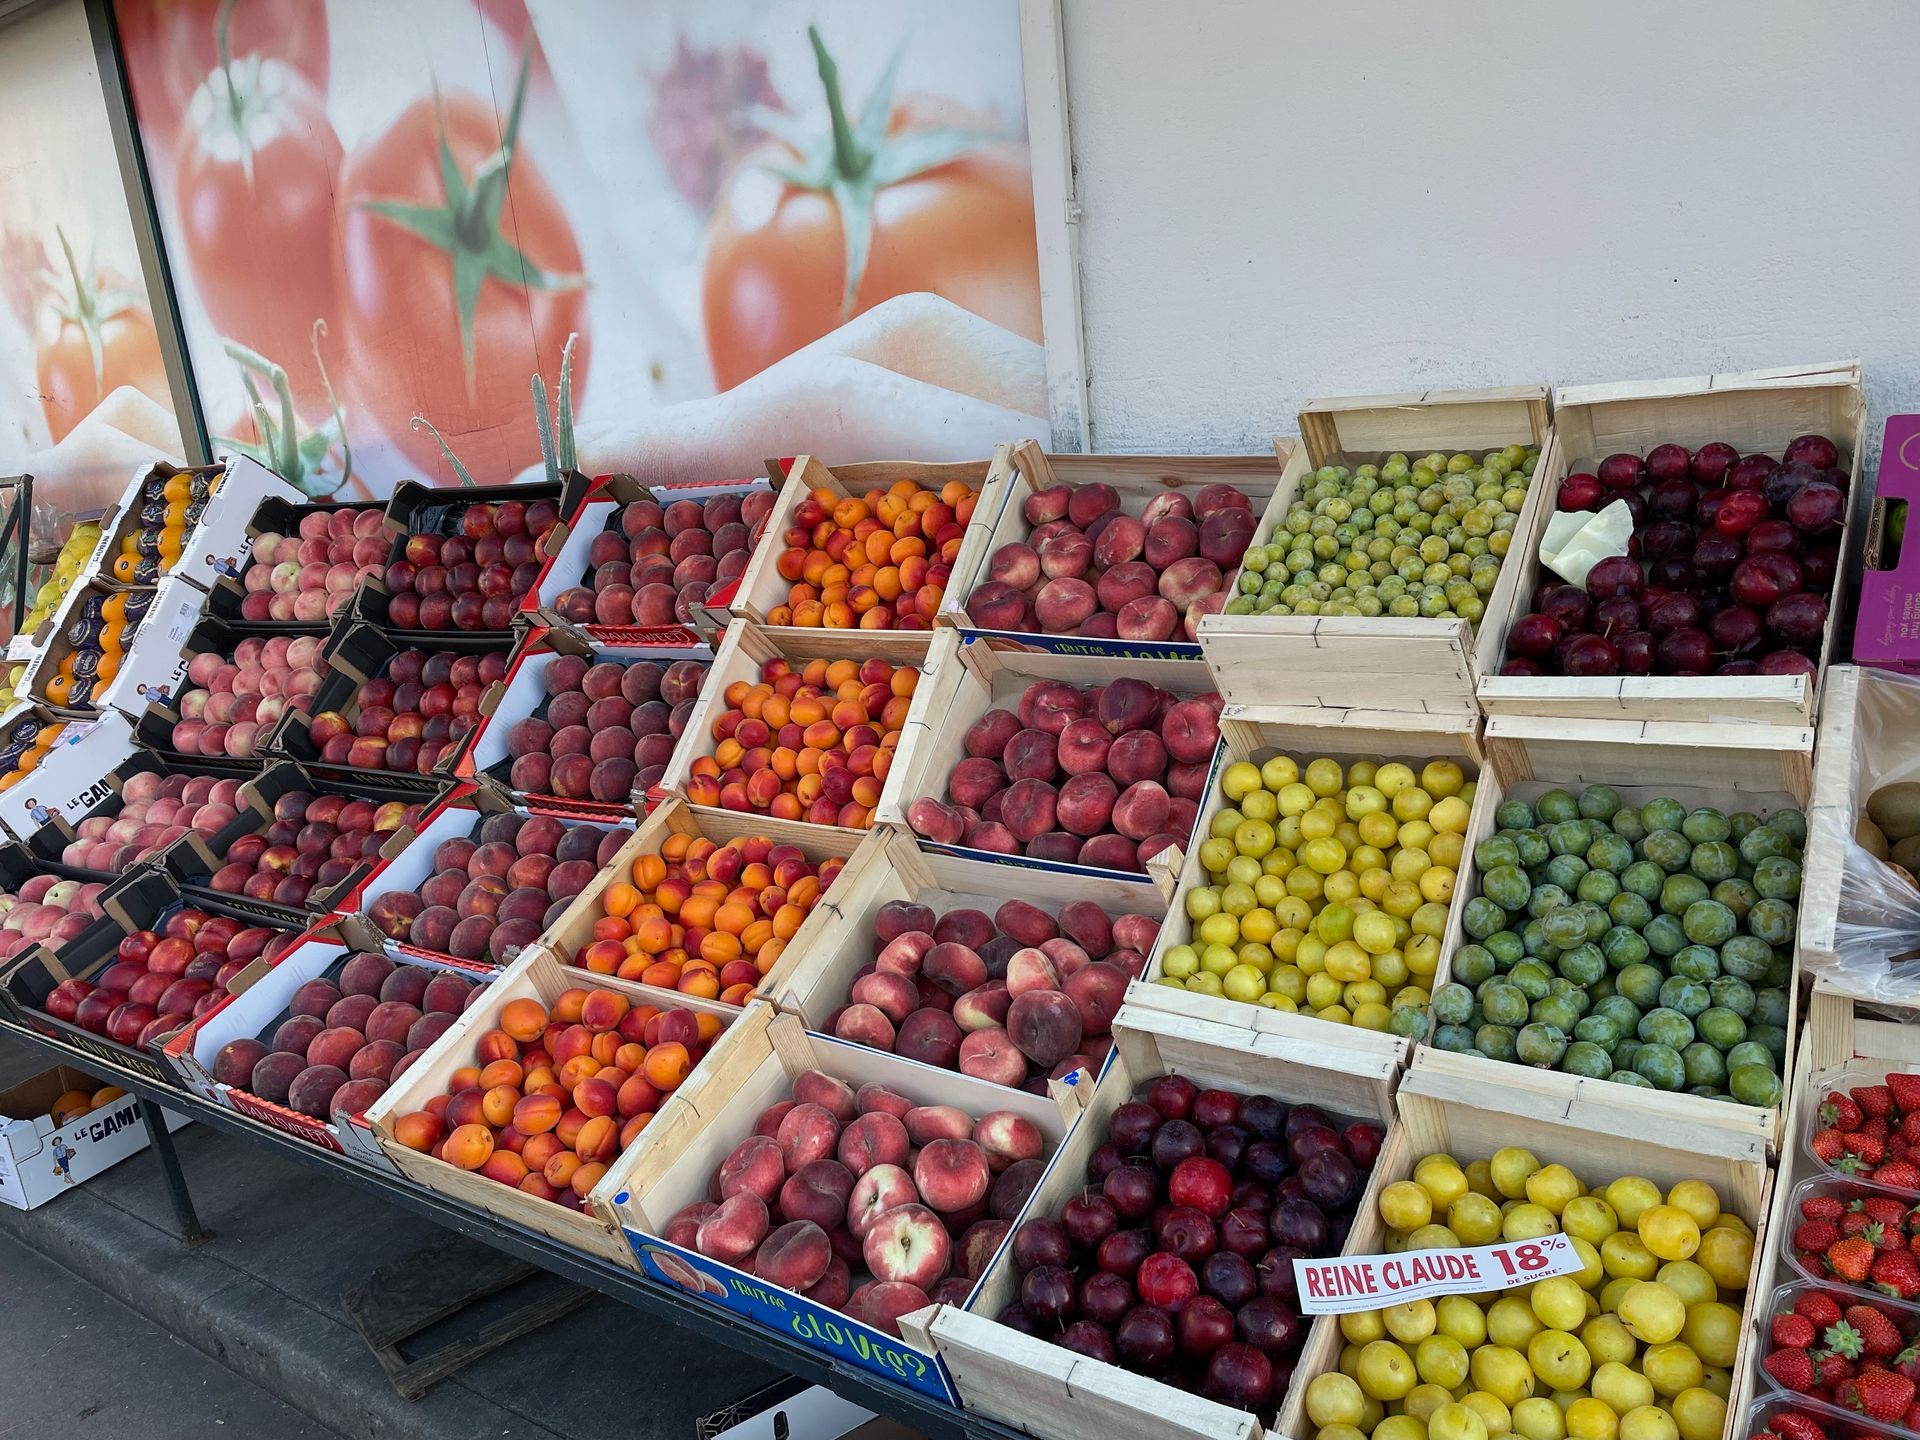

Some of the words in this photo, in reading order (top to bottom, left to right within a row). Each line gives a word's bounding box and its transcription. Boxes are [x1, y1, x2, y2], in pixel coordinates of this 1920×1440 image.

[238, 543, 249, 555] LE
[1903, 593, 1913, 620] makes
[1900, 622, 1909, 638] you
[171, 670, 182, 681] LE
[66, 798, 80, 810] LE
[78, 778, 113, 809] GAM
[67, 1033, 115, 1062] FENIX
[113, 1052, 167, 1082] FRESH
[74, 1127, 88, 1141] LE
[89, 1102, 142, 1143] GAMI
[1491, 1238, 1567, 1276] 18%
[1305, 1264, 1379, 1298] REINE
[1382, 1254, 1481, 1291] CLAUDE
[1507, 1278, 1521, 1286] DE
[730, 1279, 787, 1312] FRUTAS
